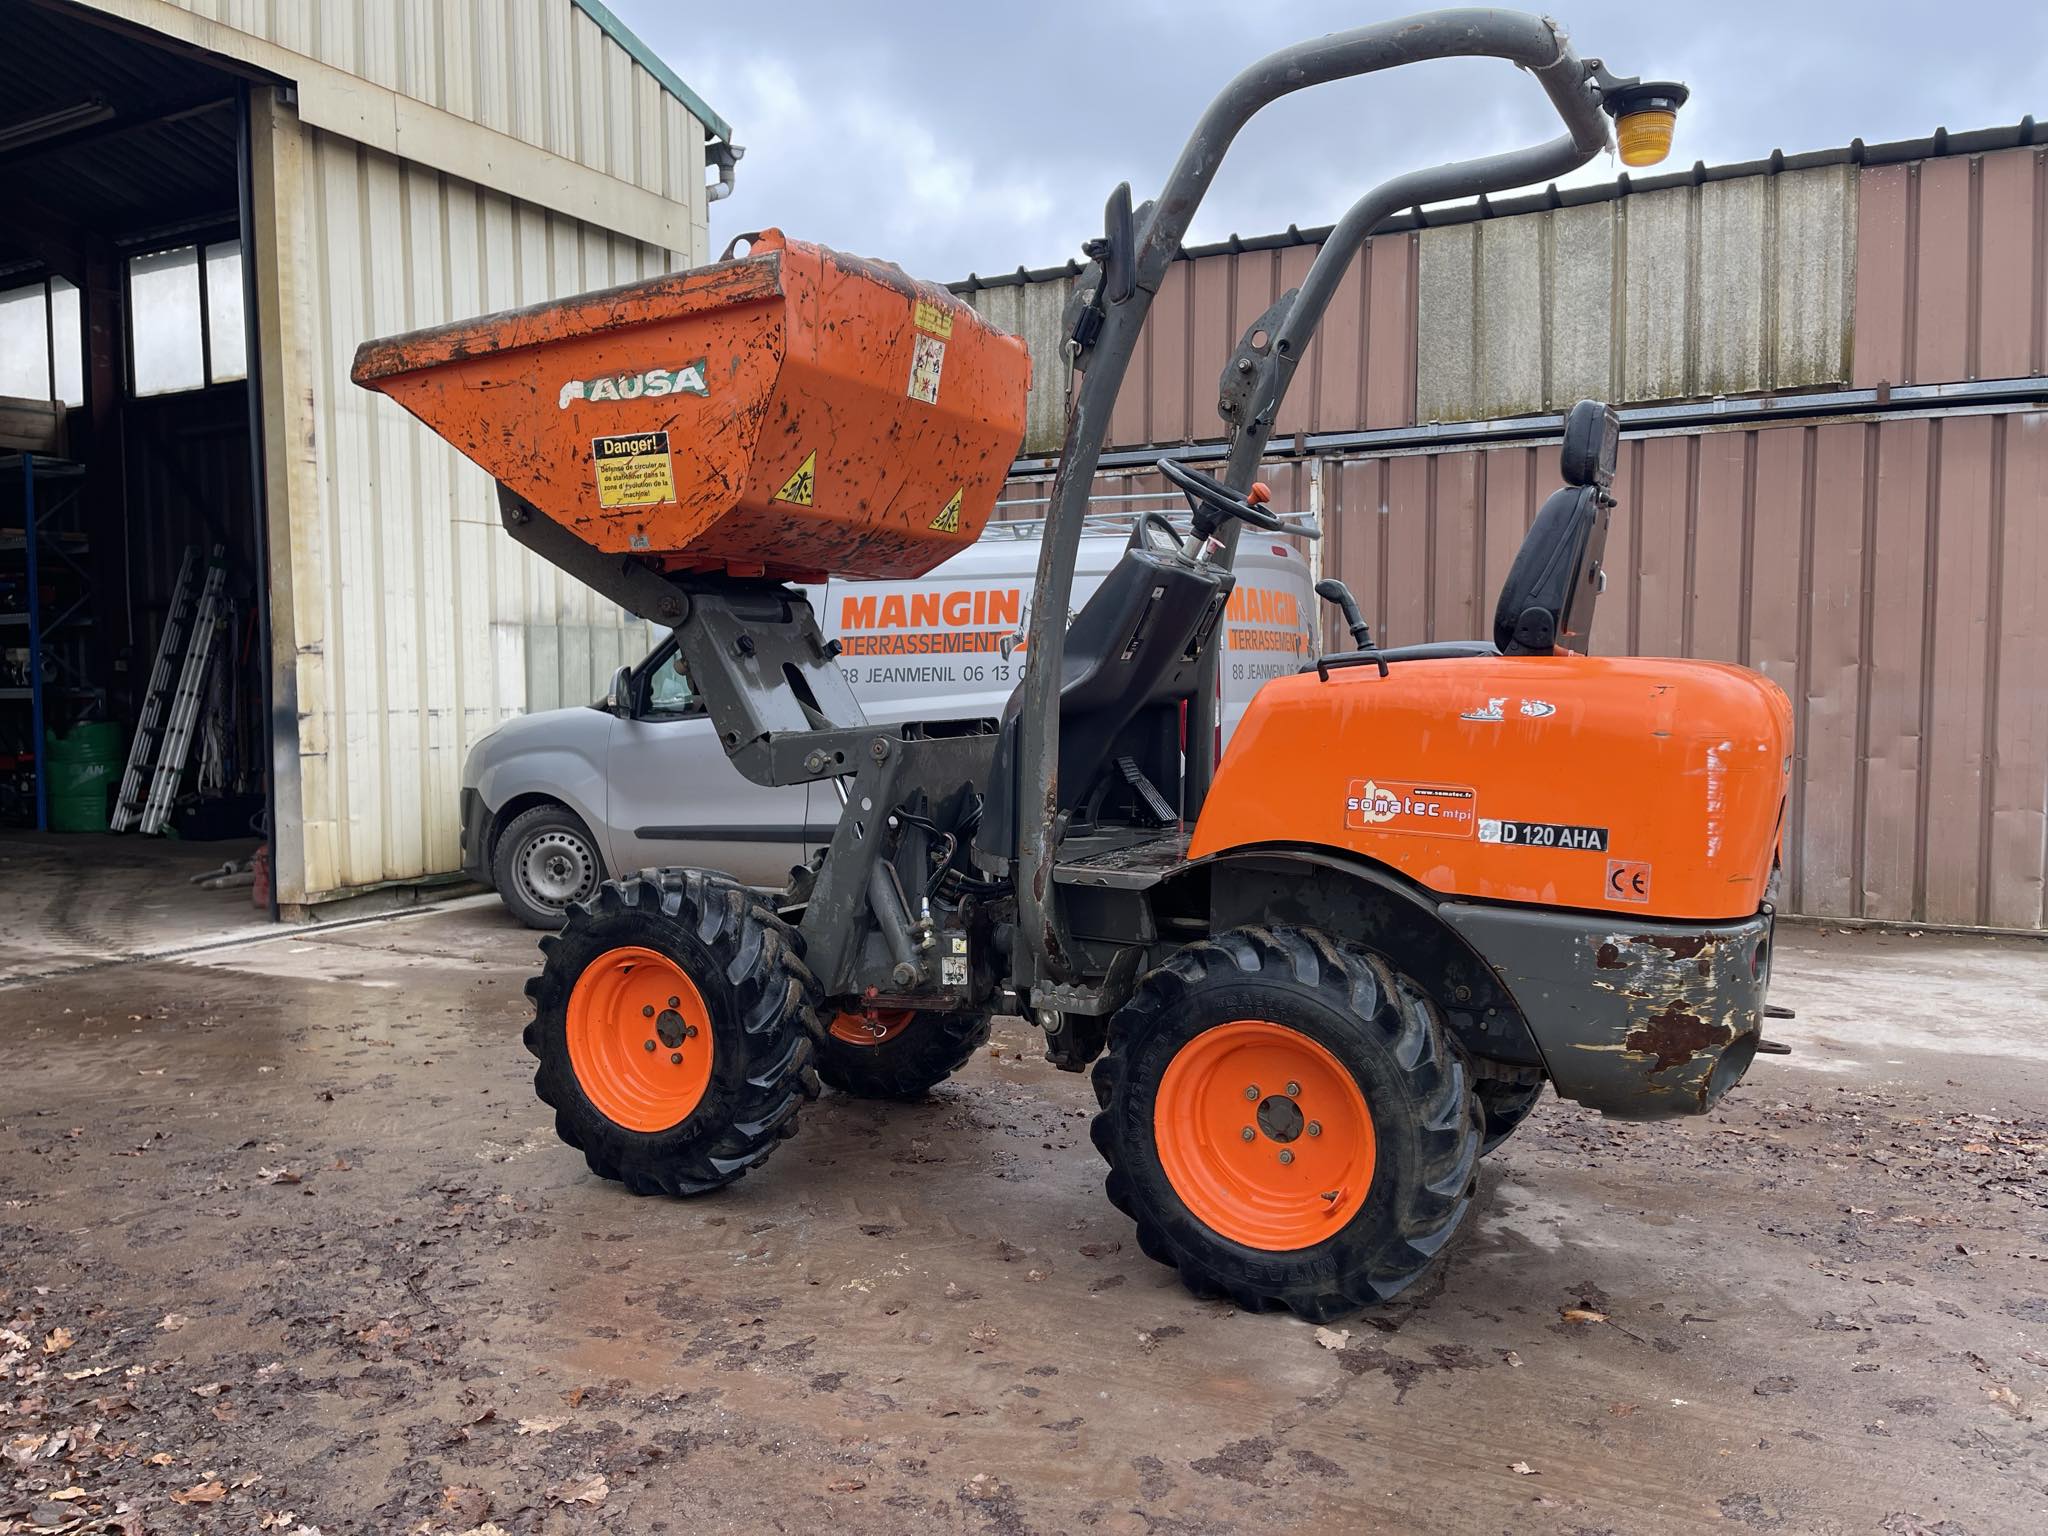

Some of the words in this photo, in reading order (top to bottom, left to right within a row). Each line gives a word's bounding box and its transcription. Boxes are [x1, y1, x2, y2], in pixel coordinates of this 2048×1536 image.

[590, 366, 706, 402] AUSA
[603, 435, 657, 456] Danger!
[840, 589, 1020, 630] MANGIN
[1226, 586, 1298, 626] MANGIN
[865, 666, 956, 683] JEANMENIL
[963, 666, 984, 681] 06
[991, 665, 1010, 681] 13
[1232, 663, 1244, 680] 88
[1414, 788, 1473, 799] www.somatec.fr
[1347, 797, 1440, 817] somatec
[1442, 809, 1471, 822] mtpi
[1503, 823, 1518, 842] D
[1522, 825, 1555, 846] 120
[1558, 828, 1602, 850] AHA
[1611, 868, 1645, 894] CE
